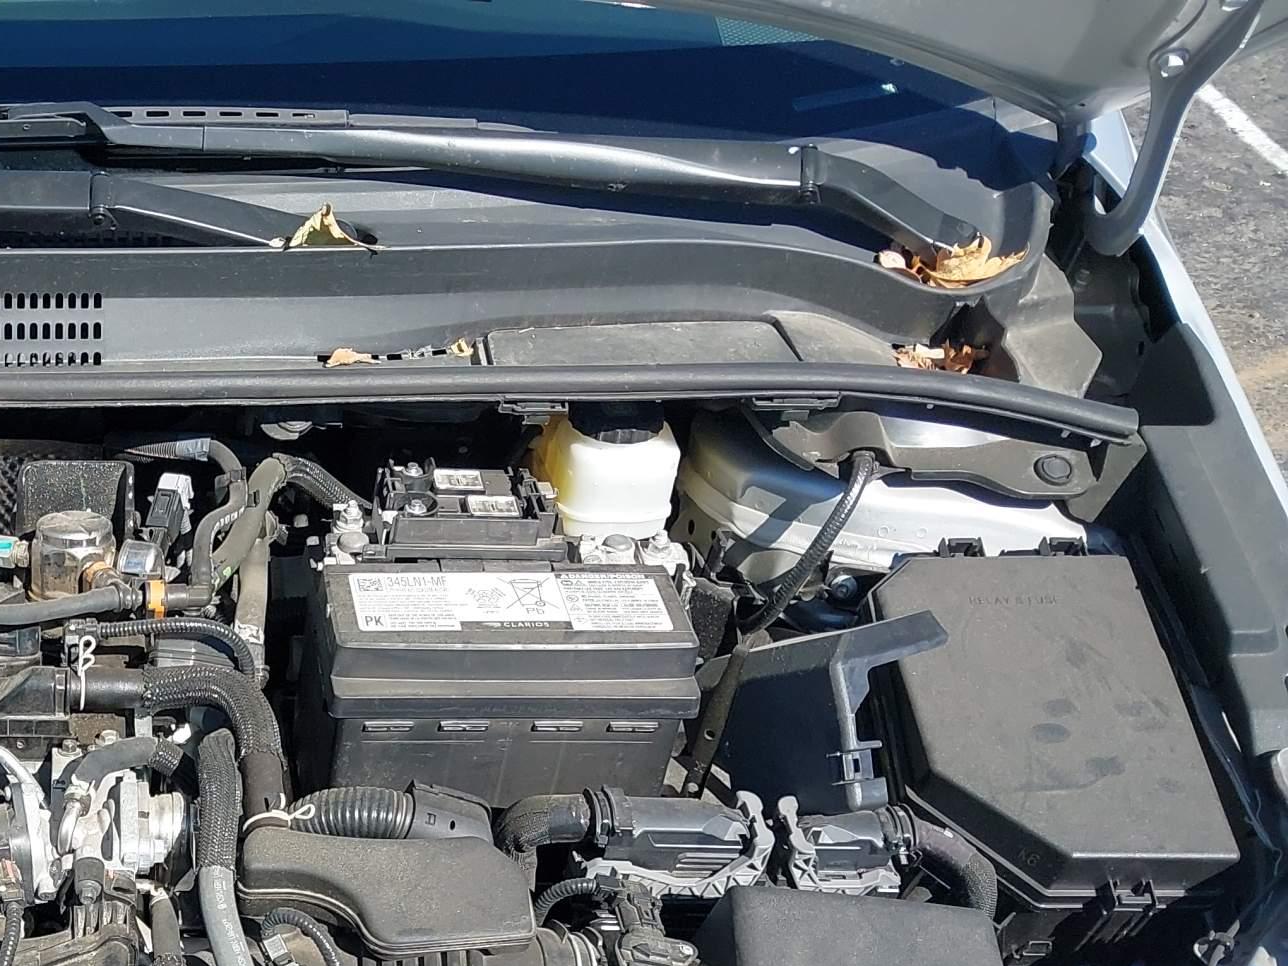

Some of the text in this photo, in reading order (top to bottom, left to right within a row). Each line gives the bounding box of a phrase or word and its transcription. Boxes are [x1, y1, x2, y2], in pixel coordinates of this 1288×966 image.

[526, 607, 545, 615] Pb
[364, 615, 384, 627] PK
[503, 621, 550, 629] CLARIOS
